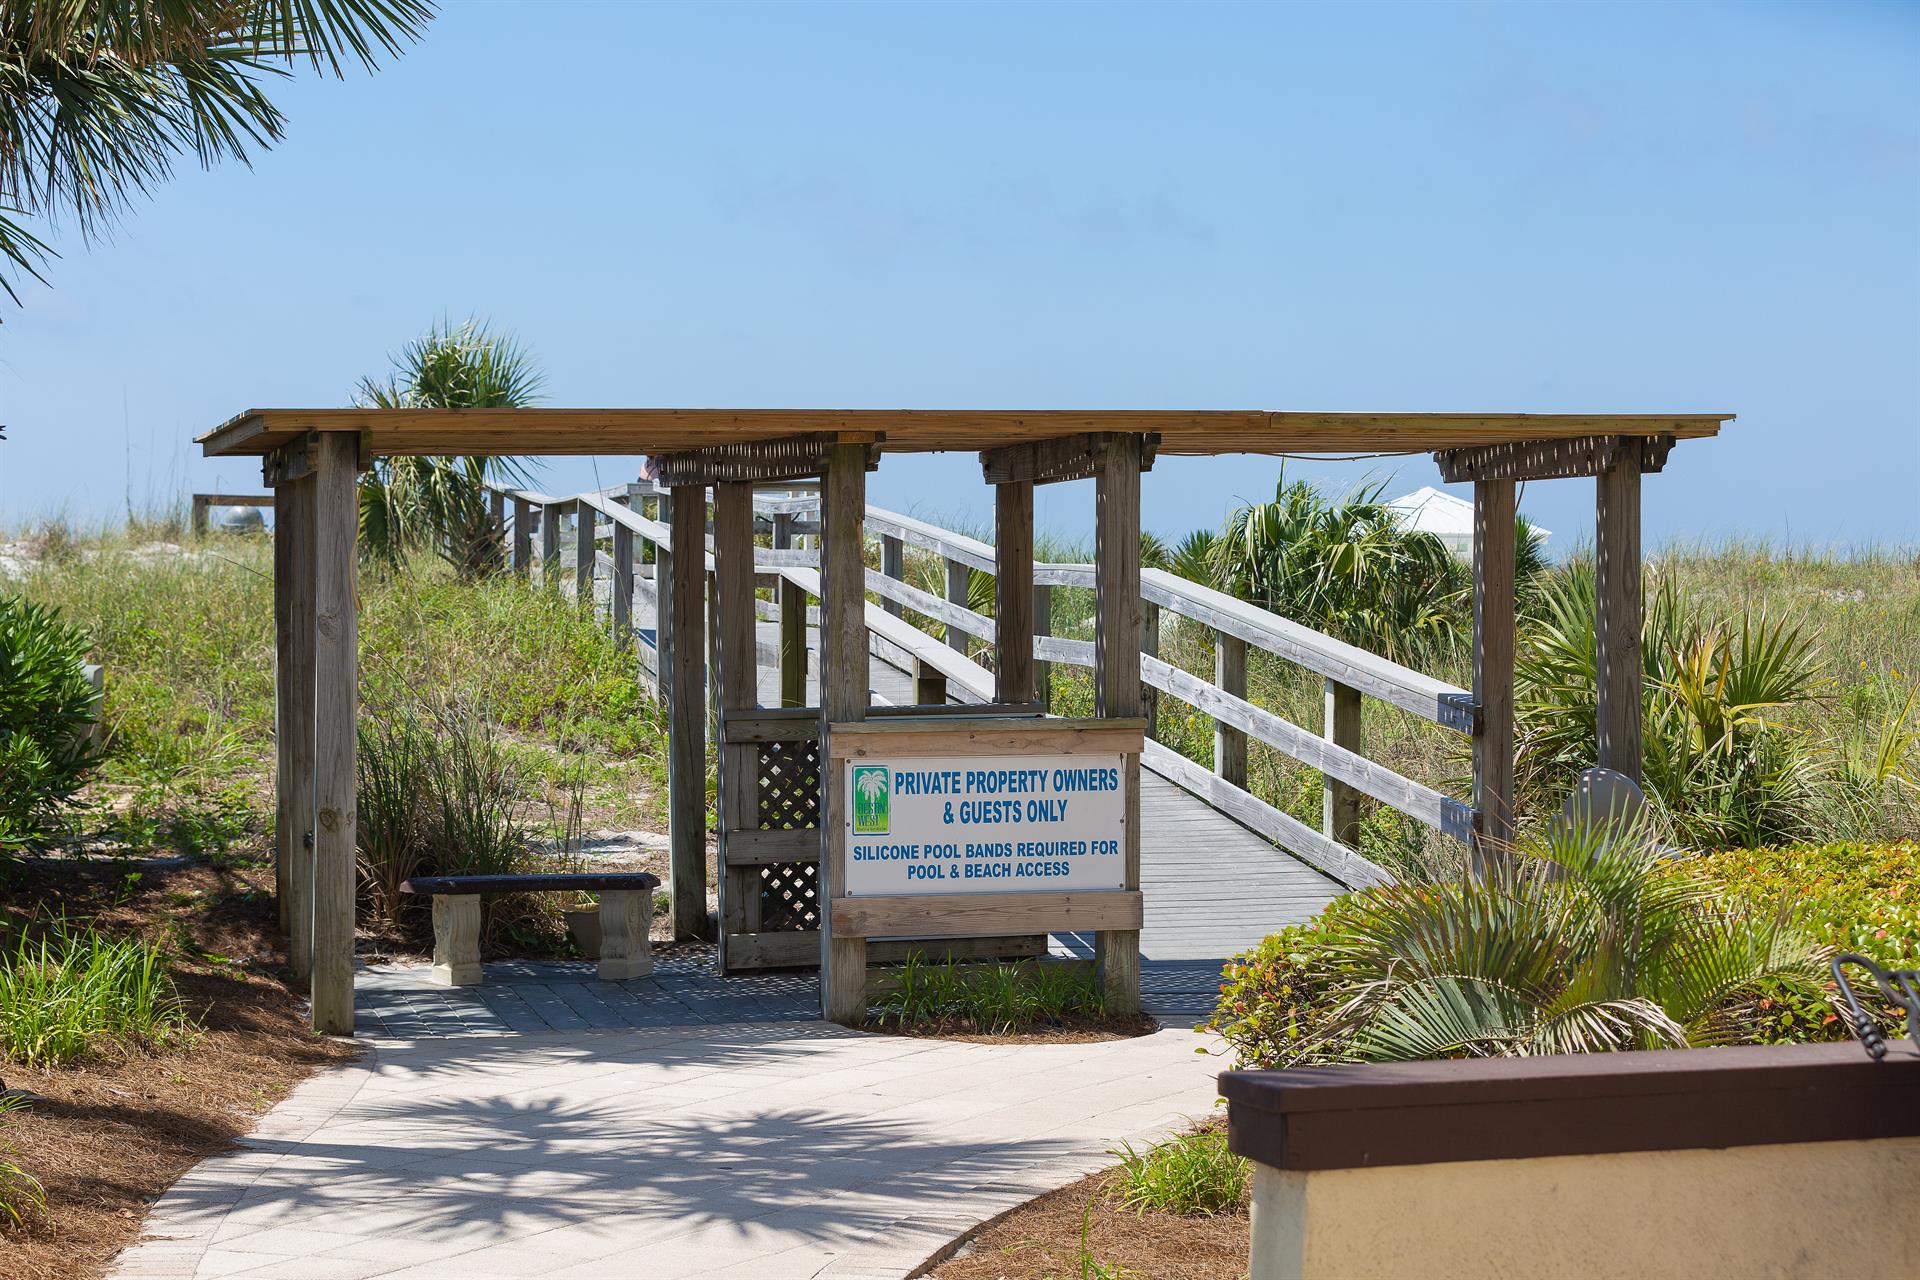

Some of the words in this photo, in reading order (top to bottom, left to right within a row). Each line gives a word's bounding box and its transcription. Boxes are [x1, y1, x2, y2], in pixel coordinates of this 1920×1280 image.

[895, 771, 961, 794] PRIVATE
[966, 768, 1048, 794] PROPERTY
[1053, 768, 1118, 792] OWNERS
[943, 801, 955, 824] &
[959, 800, 1022, 824] GUESTS
[1027, 800, 1067, 823] ONLY
[853, 844, 919, 861] SILICONE
[925, 843, 961, 859] POOL
[965, 843, 1013, 859] BANDS
[1017, 841, 1087, 858] REQUIRED
[1091, 840, 1118, 855] FOR
[908, 864, 945, 880] POOL
[950, 864, 960, 879] &
[964, 863, 1012, 879] BEACH
[1016, 861, 1070, 878] ACCESS
